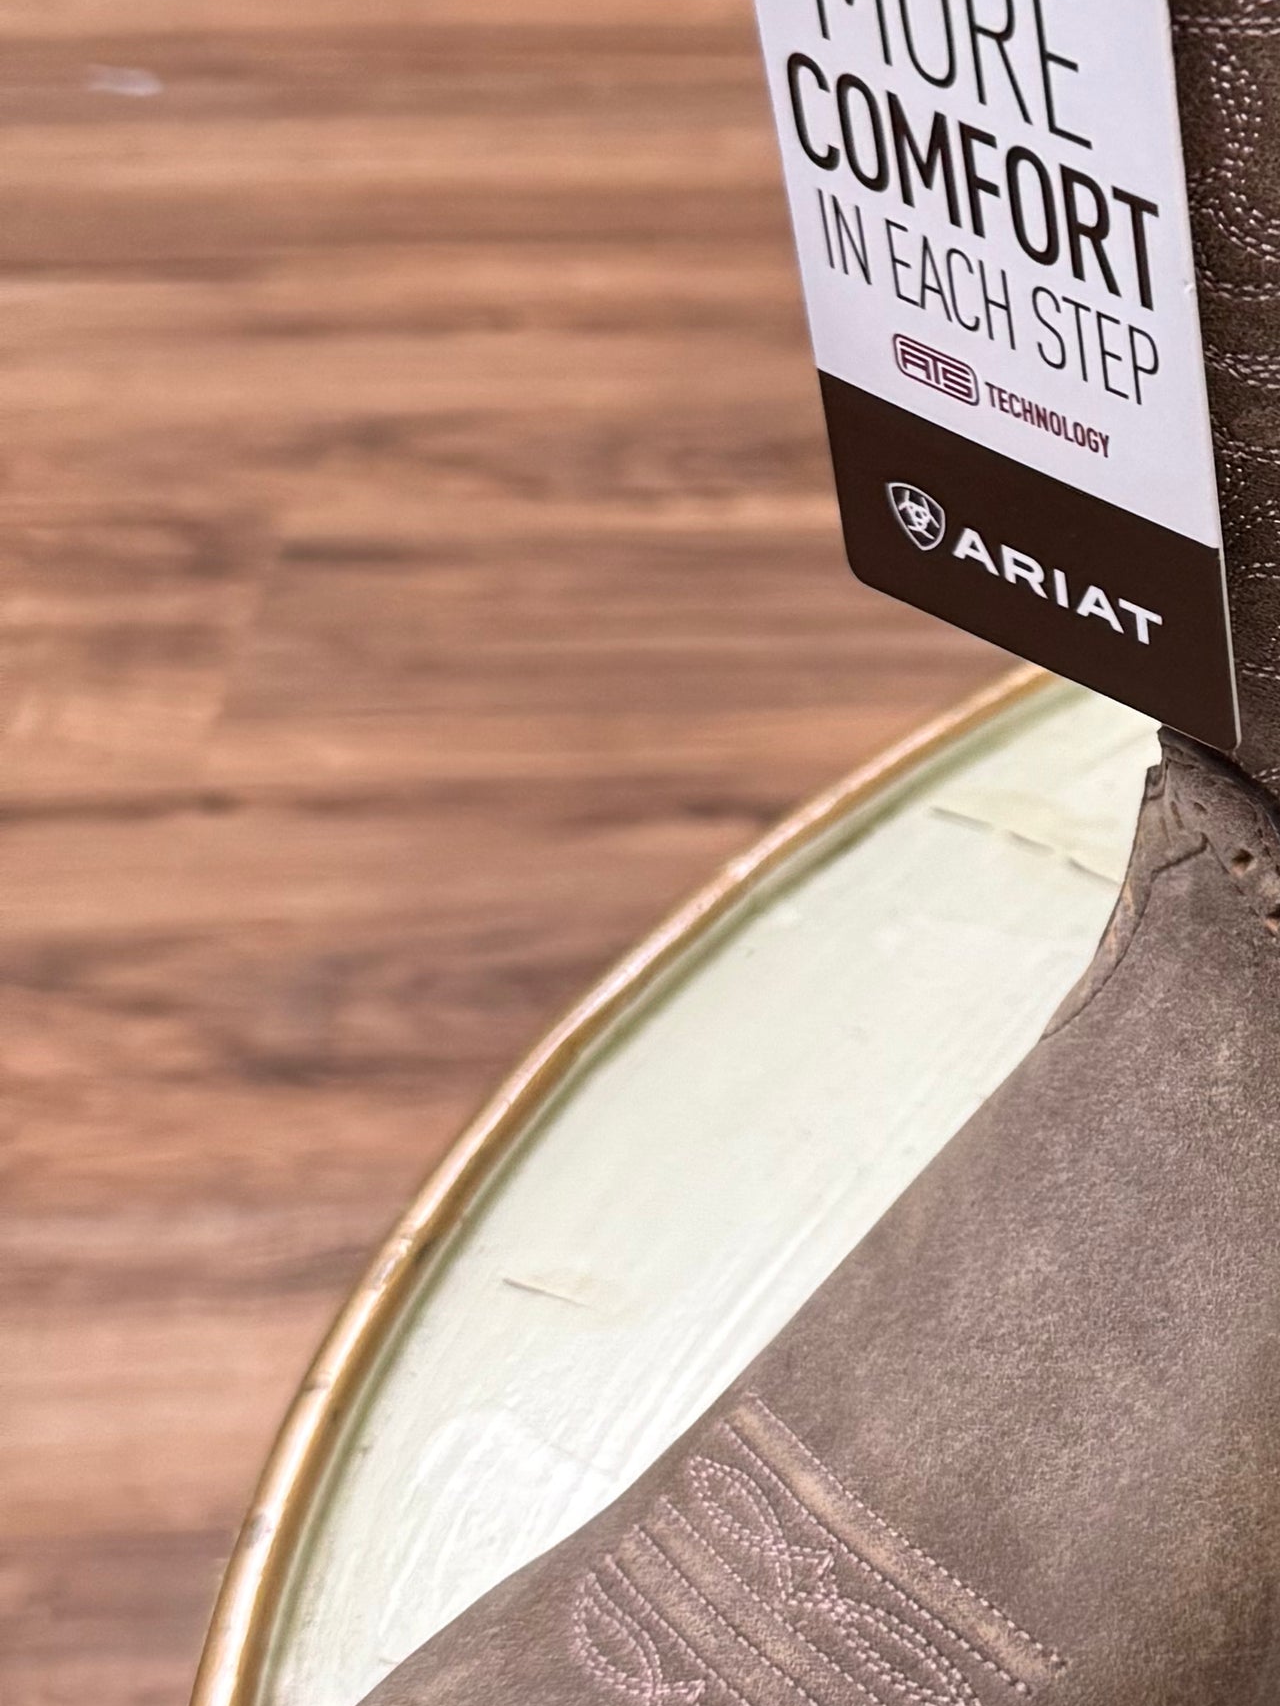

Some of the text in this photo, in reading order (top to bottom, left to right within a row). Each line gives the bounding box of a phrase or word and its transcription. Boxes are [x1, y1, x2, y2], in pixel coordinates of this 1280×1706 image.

[785, 51, 1160, 310] COMFORT
[816, 188, 1161, 406] IN EACH STEP
[895, 336, 1110, 458] ATS TECHNOLOGY
[952, 526, 1164, 646] ARIAT
